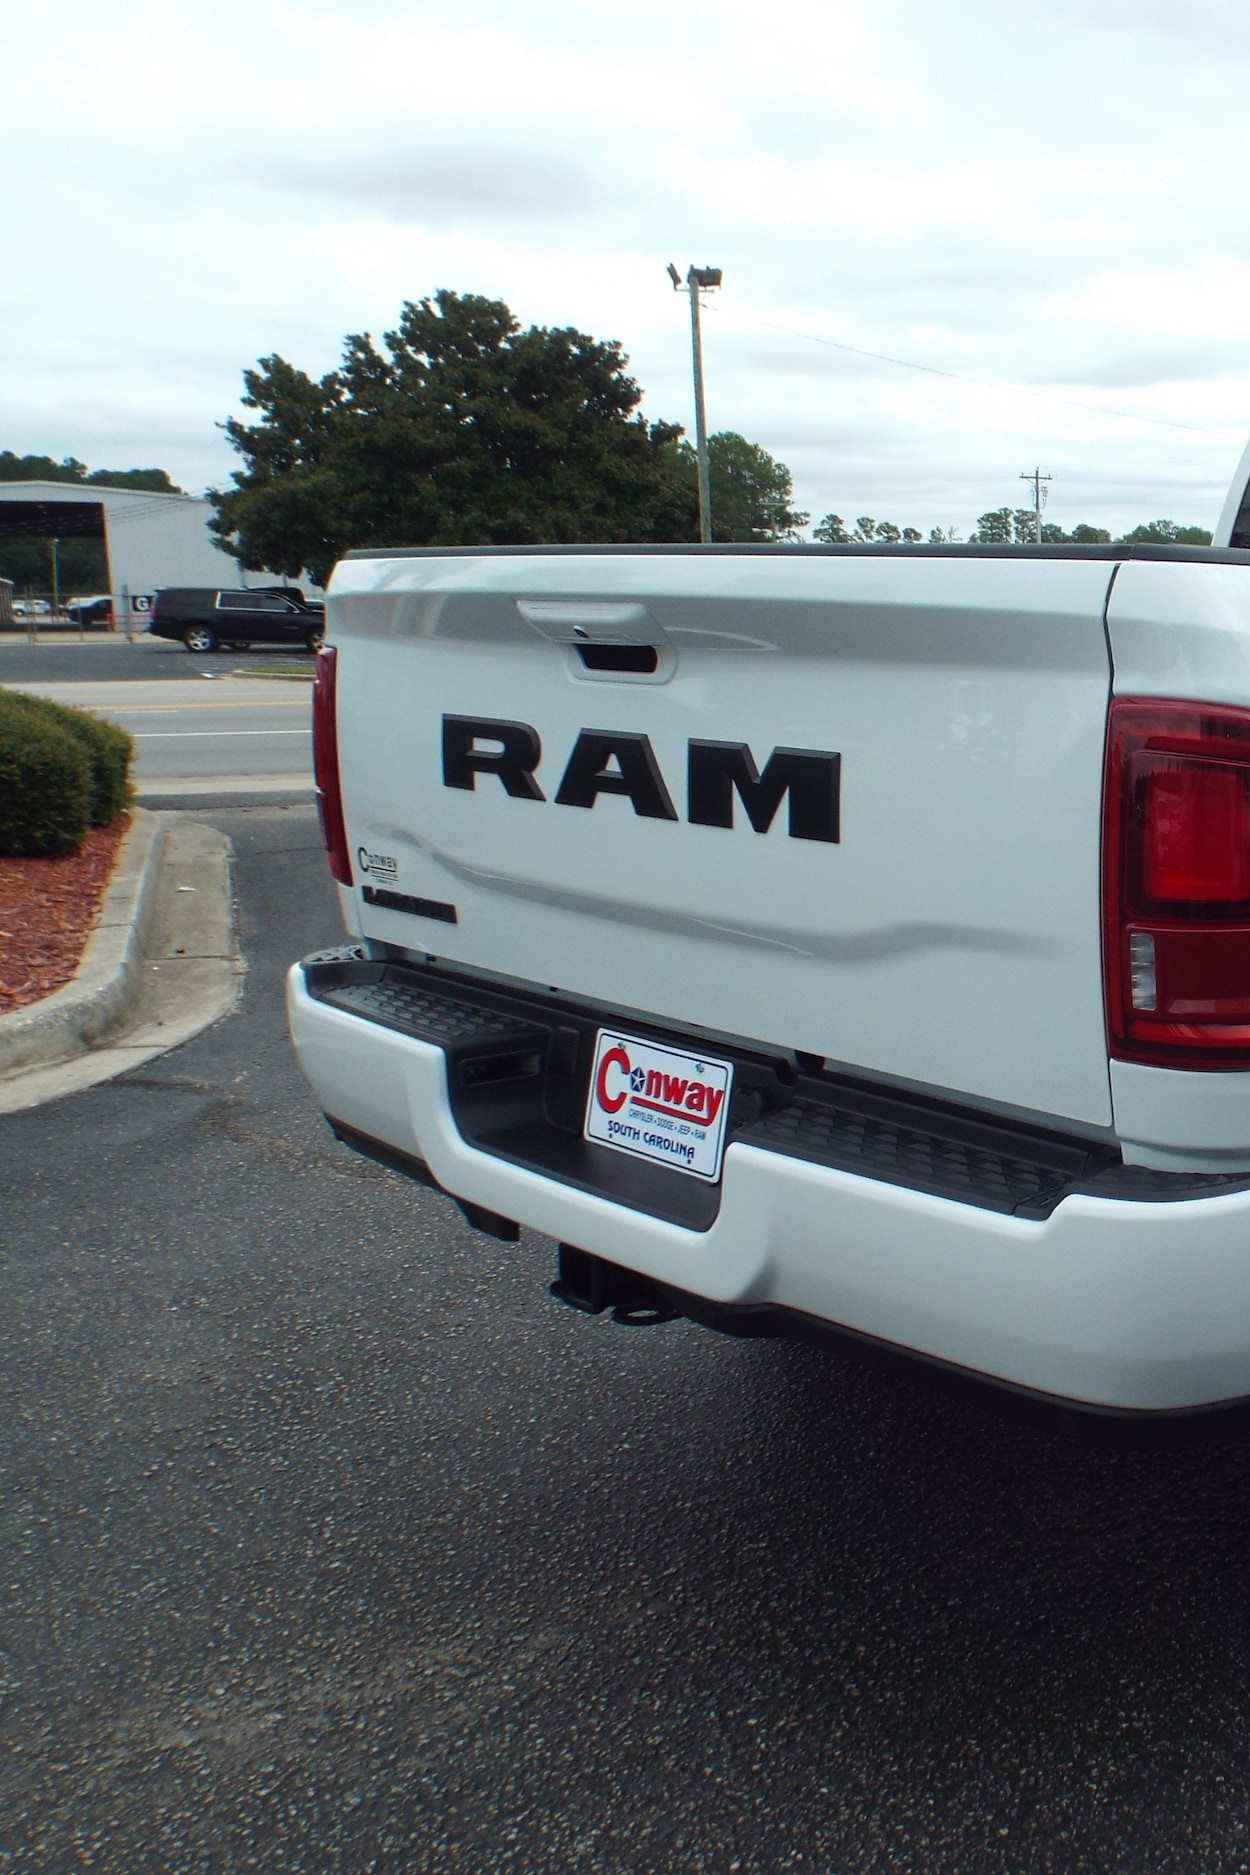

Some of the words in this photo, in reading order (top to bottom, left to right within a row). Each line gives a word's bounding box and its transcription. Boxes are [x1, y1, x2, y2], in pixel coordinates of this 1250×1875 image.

[442, 713, 841, 844] RAM
[358, 846, 397, 873] Conway
[596, 1047, 725, 1127] Conway
[607, 1120, 641, 1141] SOUTH
[643, 1132, 695, 1158] CAROLINA
